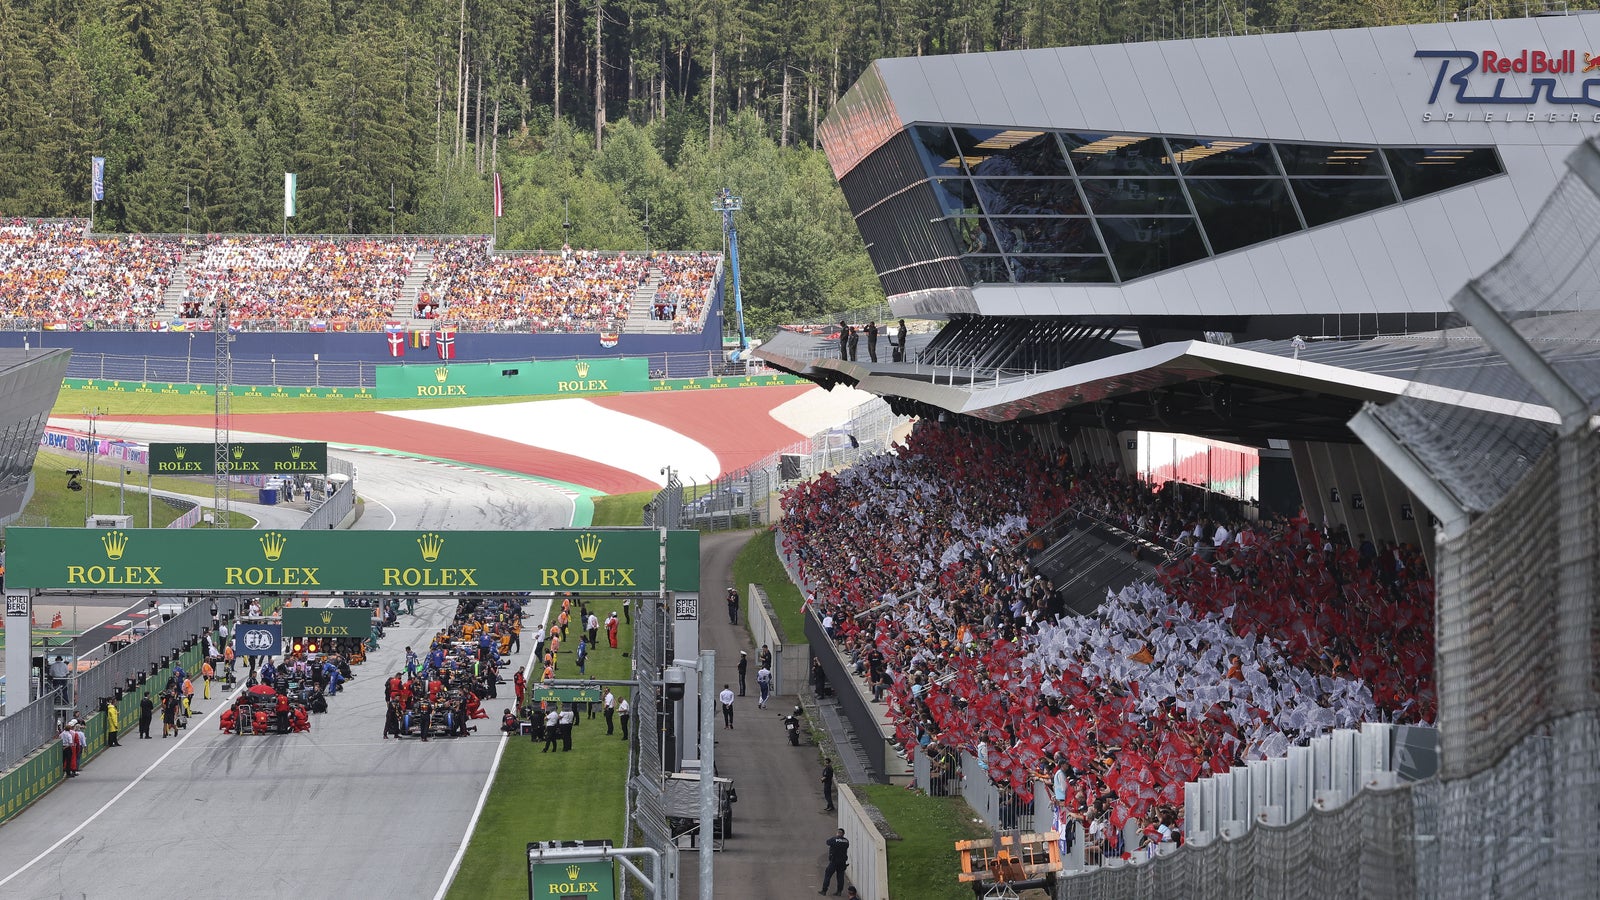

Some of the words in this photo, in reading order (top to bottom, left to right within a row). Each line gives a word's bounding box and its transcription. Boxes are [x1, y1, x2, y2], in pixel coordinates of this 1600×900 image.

[1482, 49, 1527, 74] Red
[1532, 49, 1575, 74] Bull
[417, 385, 467, 396] ROLEX
[557, 380, 608, 391] ROLEX
[48, 433, 68, 448] BWT
[81, 439, 100, 453] BWT
[158, 462, 202, 471] ROLEX
[274, 461, 318, 470] ROLEX
[67, 565, 162, 585] ROLEX
[225, 567, 320, 586] ROLEX
[382, 568, 478, 586] ROLEX
[540, 568, 636, 587] ROLEX
[305, 626, 348, 635] ROLEX
[246, 633, 270, 646] FIA
[549, 882, 599, 894] ROLEX
